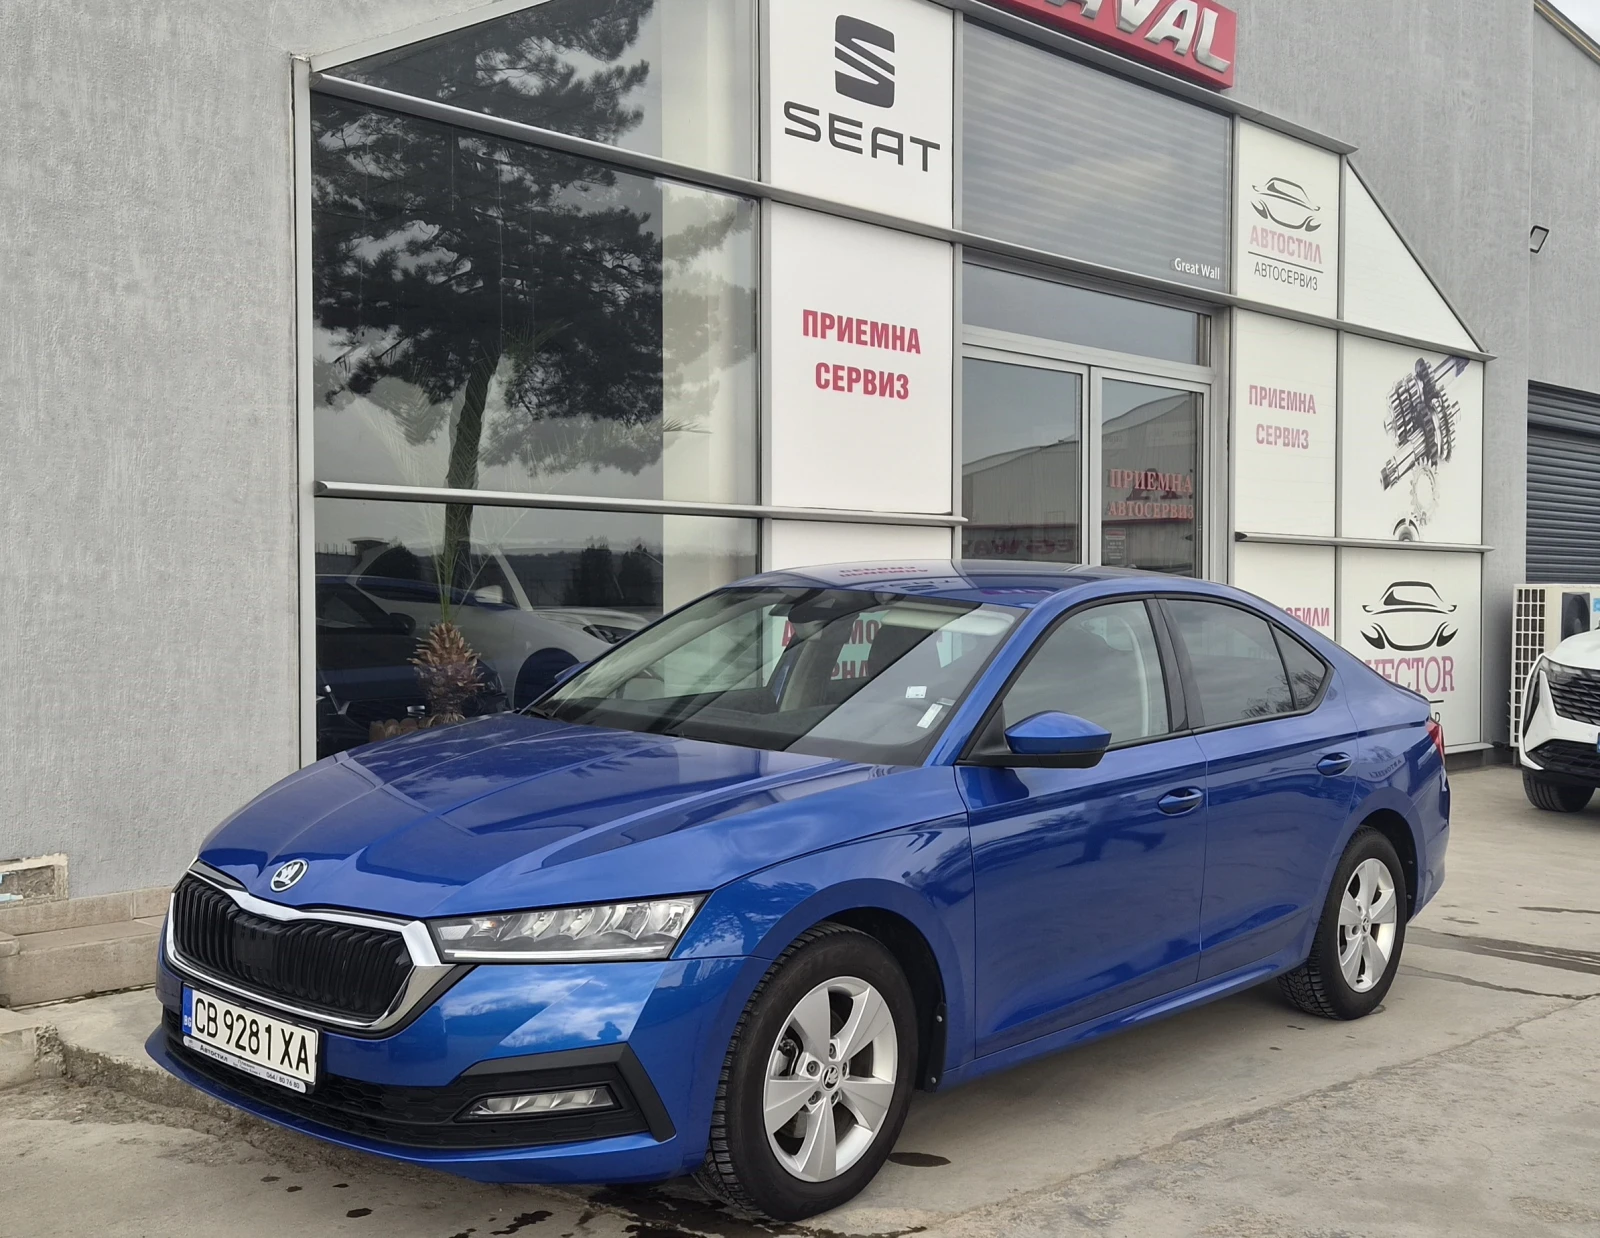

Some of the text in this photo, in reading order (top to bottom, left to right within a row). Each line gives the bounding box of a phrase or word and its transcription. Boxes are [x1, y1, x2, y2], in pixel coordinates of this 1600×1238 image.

[784, 101, 940, 172] SEAT
[1250, 225, 1322, 264] АВТОСТИЛ
[1174, 257, 1220, 280] Great Wall
[1254, 261, 1318, 291] АВТОСЕРВИЗ
[803, 308, 921, 355] ПРИЕМНА
[815, 362, 909, 400] СЕРВИЗ
[1249, 385, 1316, 414] ПРИЕМНА
[1256, 424, 1309, 449] СЕРВИЗ
[1110, 468, 1193, 492] ПРИЕМНА
[1108, 501, 1194, 519] АВТОСЕРВИЗ
[183, 1014, 192, 1028] BG
[223, 1009, 272, 1061] 9281
